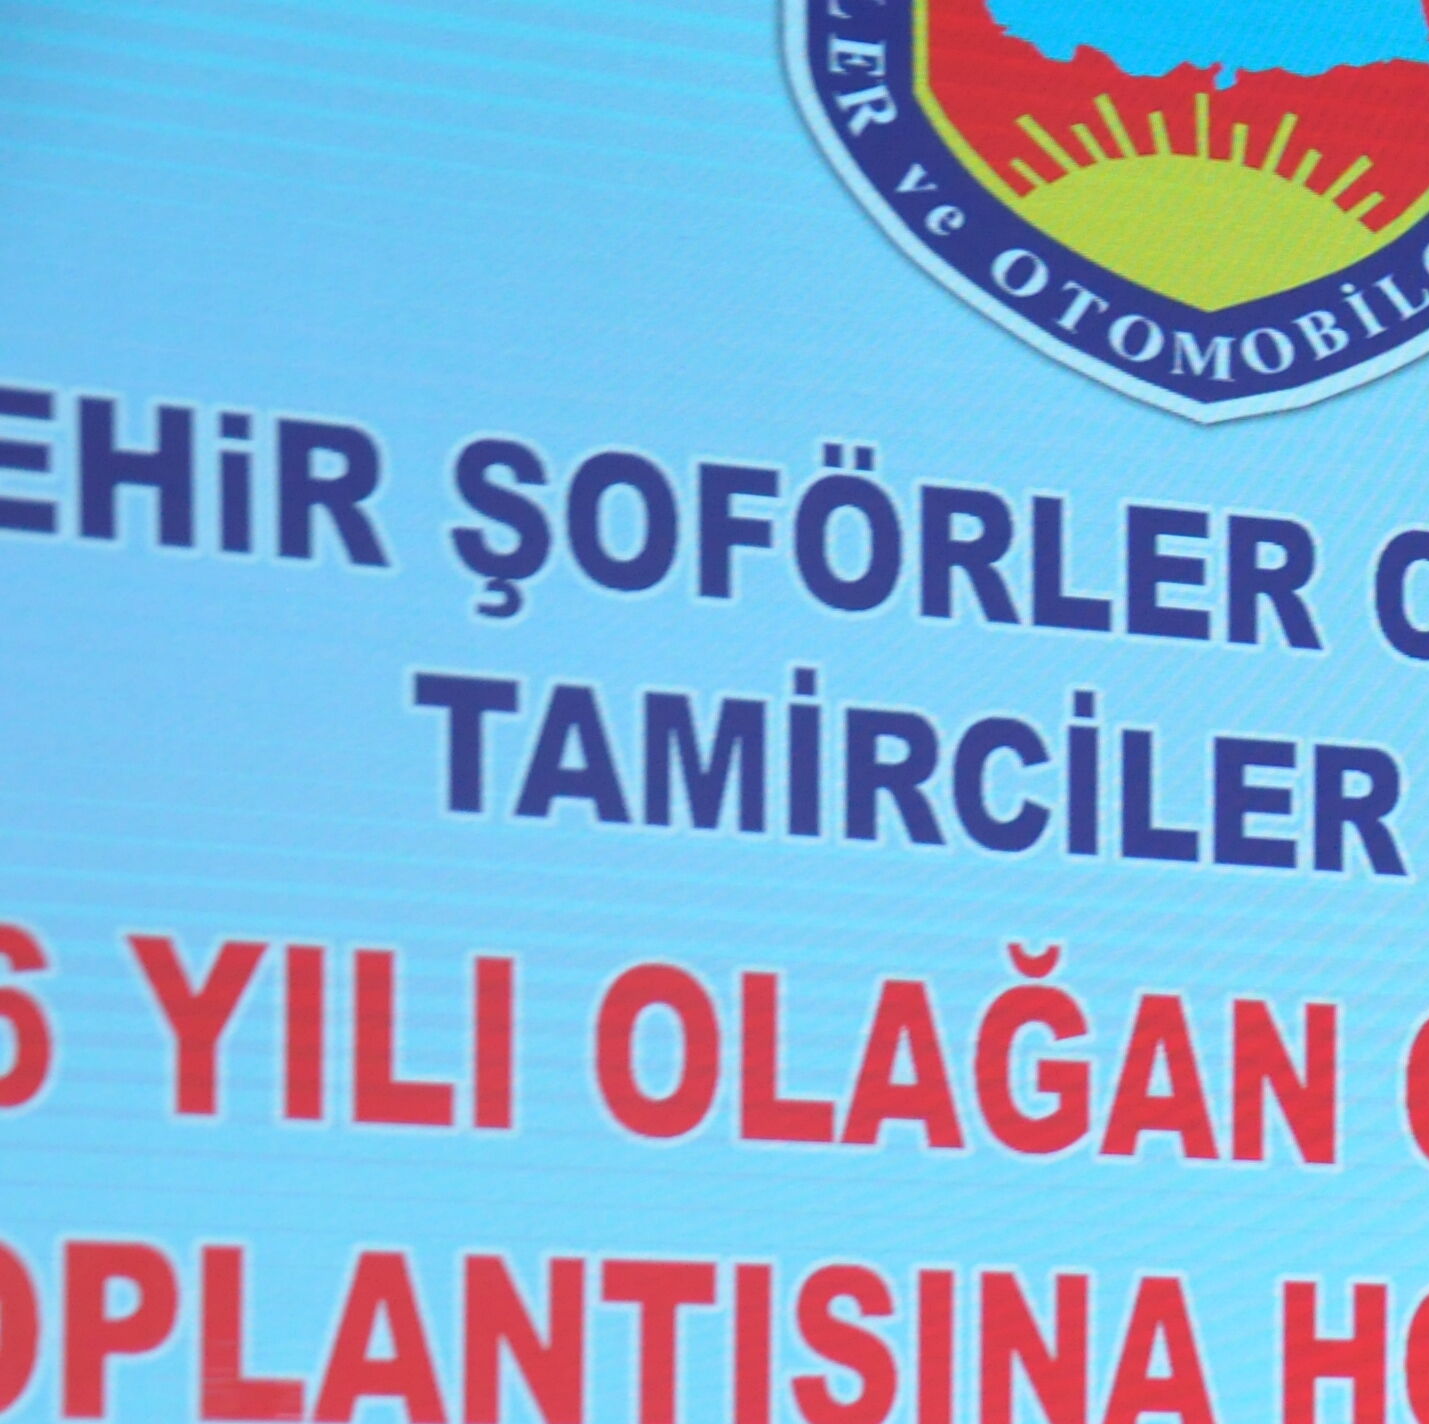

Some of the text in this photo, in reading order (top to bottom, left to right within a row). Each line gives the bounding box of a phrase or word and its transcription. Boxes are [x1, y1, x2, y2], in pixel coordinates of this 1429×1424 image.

[894, 162, 966, 236] ve
[451, 438, 1322, 651] ŞOFÖRLER
[413, 667, 1408, 877] TAMİRCİLER
[126, 934, 513, 1130] YILI
[595, 943, 1337, 1165] OLAĞAN
